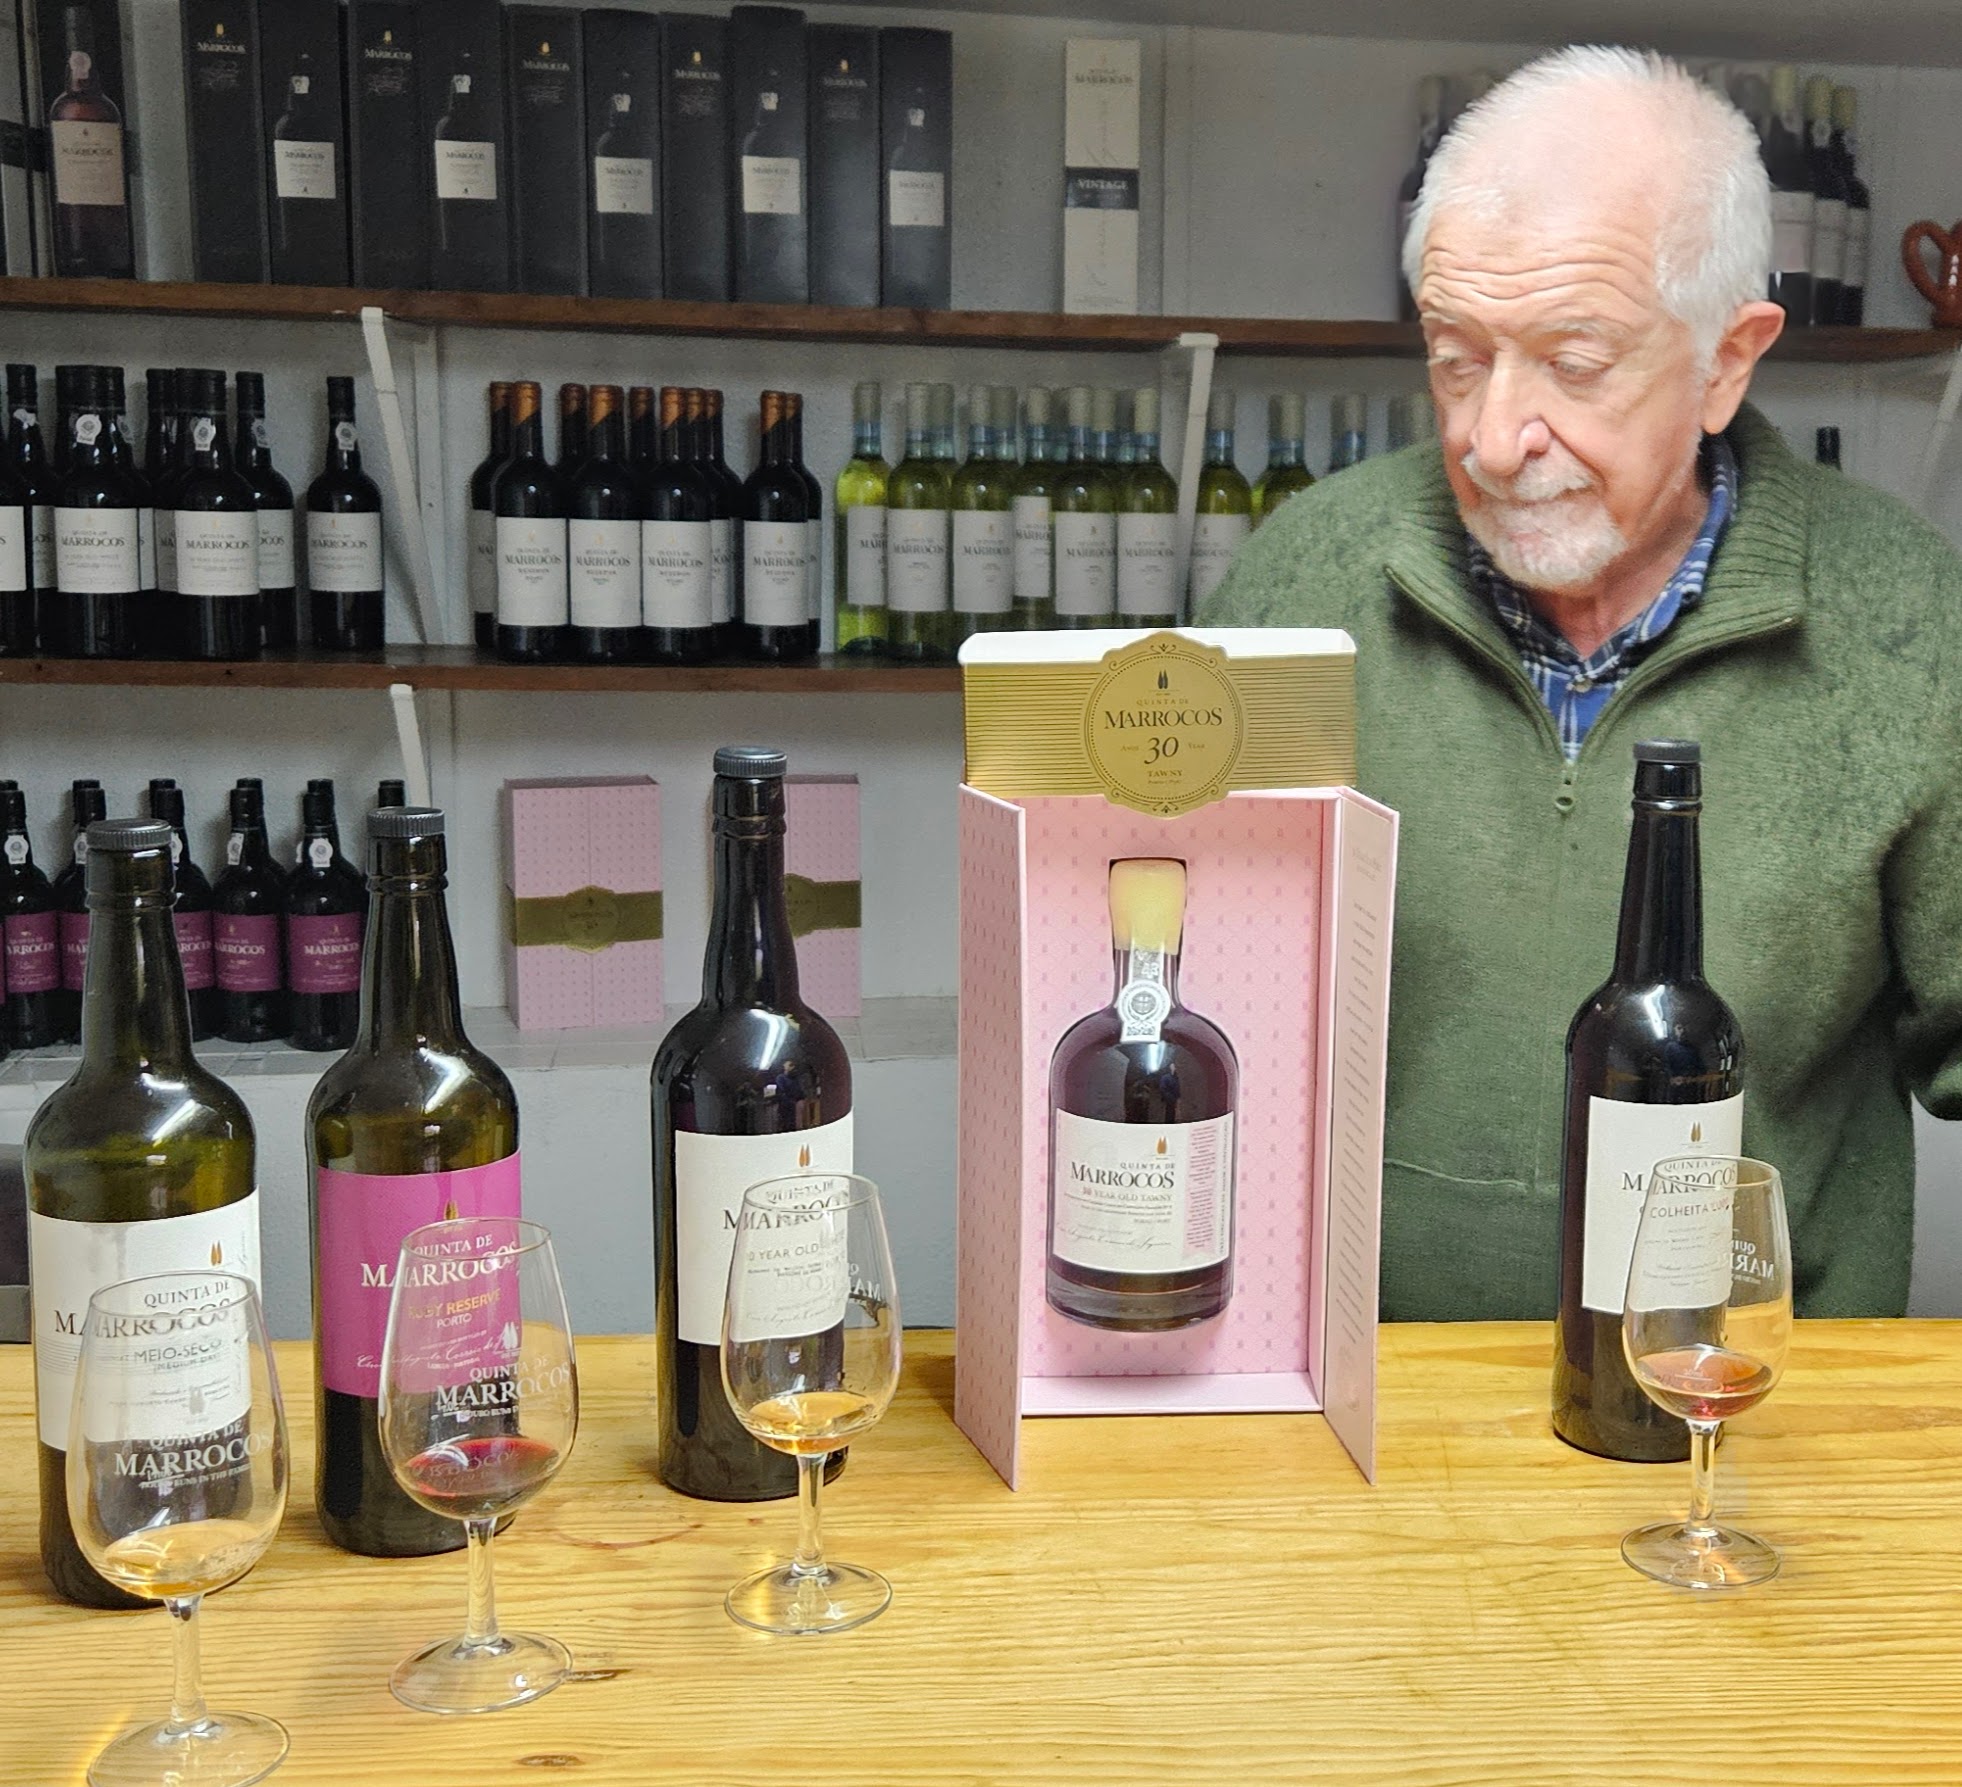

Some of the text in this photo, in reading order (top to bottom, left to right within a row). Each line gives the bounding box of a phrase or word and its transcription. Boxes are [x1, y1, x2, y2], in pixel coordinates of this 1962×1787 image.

[1078, 178, 1128, 191] VINTAGE
[1136, 698, 1177, 706] QUINTA
[1104, 707, 1223, 730] MARROCOS
[1144, 736, 1179, 765] 30
[1148, 769, 1183, 778] TAWNY
[1071, 1161, 1174, 1190] MARROCOS
[1120, 1161, 1175, 1171] QUINTA DE
[1664, 1160, 1710, 1173] QUINTA
[1094, 1188, 1115, 1200] YEAR
[1118, 1193, 1138, 1202] OLD
[413, 1234, 493, 1257] QUINTA DE
[759, 1249, 790, 1261] YEAR
[795, 1243, 820, 1255] OLD
[145, 1281, 230, 1309] QUINTA DE
[446, 1288, 502, 1315] RESERVE
[436, 1313, 473, 1329] PORTO
[134, 1338, 223, 1365] MEIO-SECO
[469, 1363, 529, 1383] QUINTA
[435, 1361, 570, 1407] MARROCOS
[222, 1420, 244, 1436] DE
[114, 1432, 272, 1477] MARROCOS
